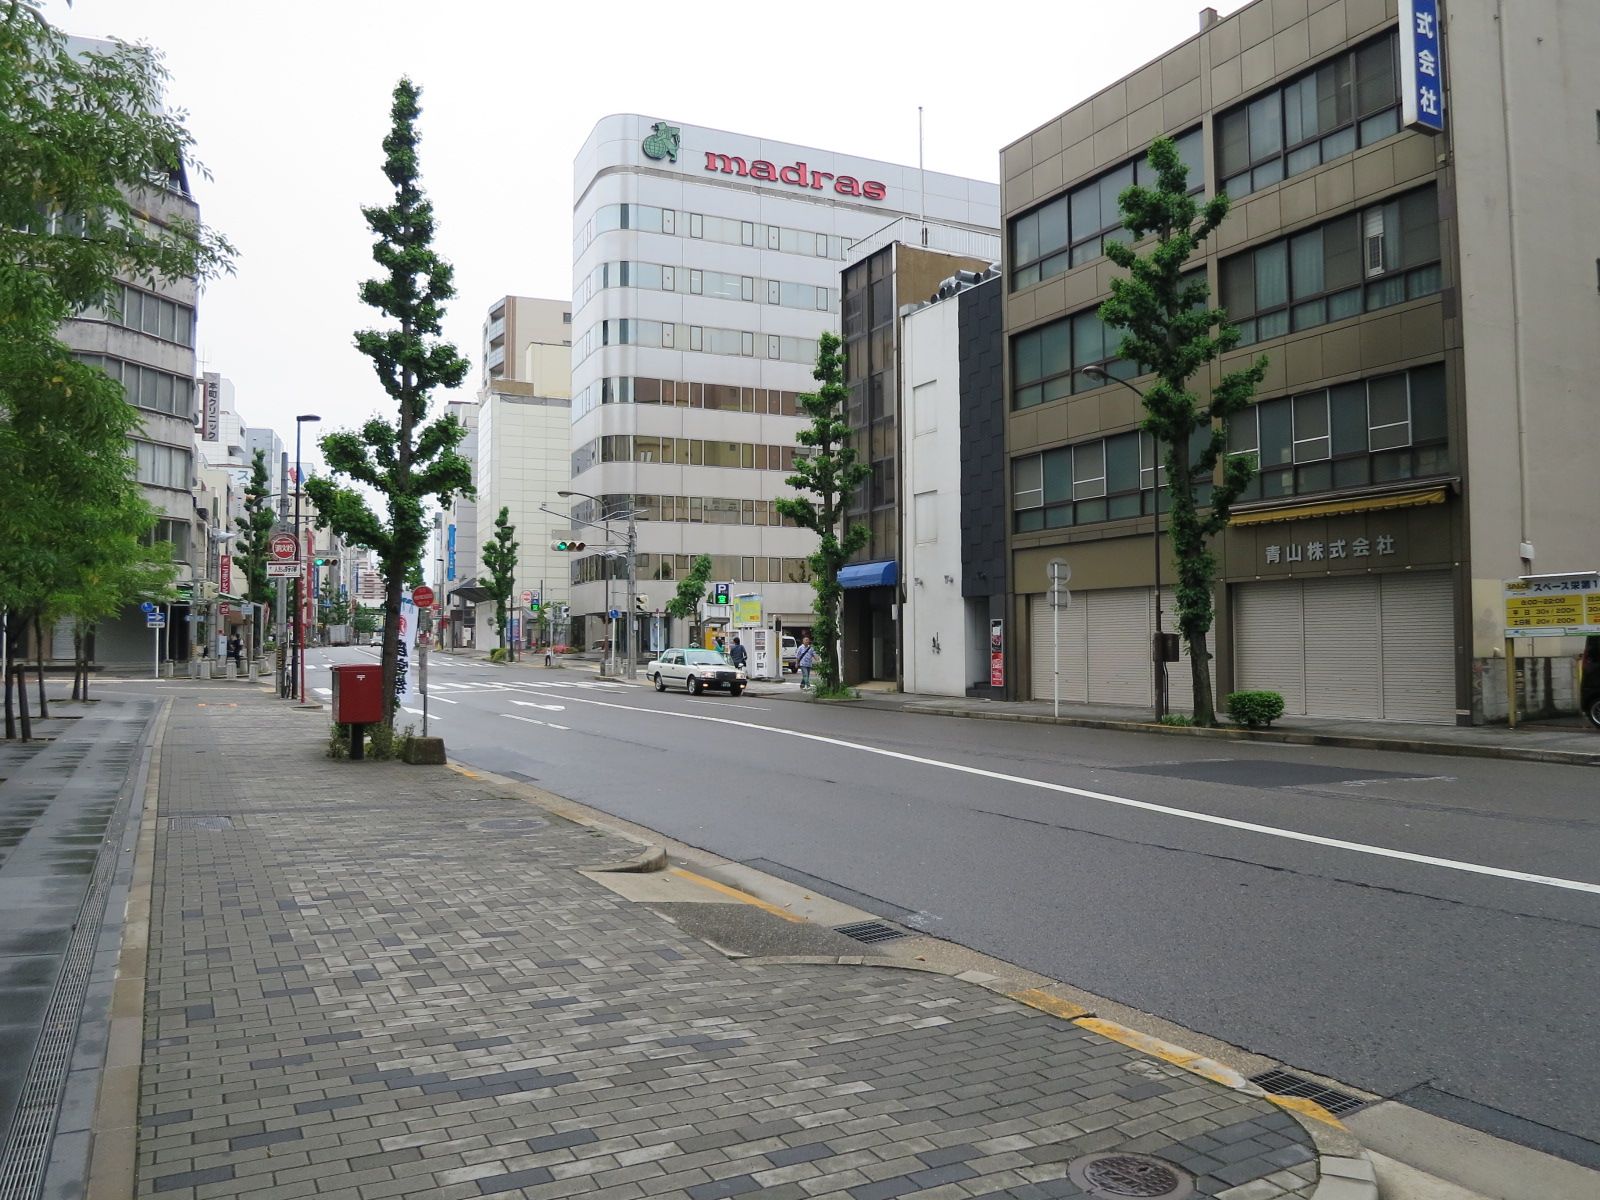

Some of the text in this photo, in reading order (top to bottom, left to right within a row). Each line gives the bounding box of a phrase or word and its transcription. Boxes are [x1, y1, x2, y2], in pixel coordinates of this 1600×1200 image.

[1415, 11, 1438, 116] 式会社
[704, 150, 887, 201] madras
[207, 382, 218, 440] 本町クリニック
[1265, 535, 1396, 564] 青山株式会社
[717, 584, 727, 594] P
